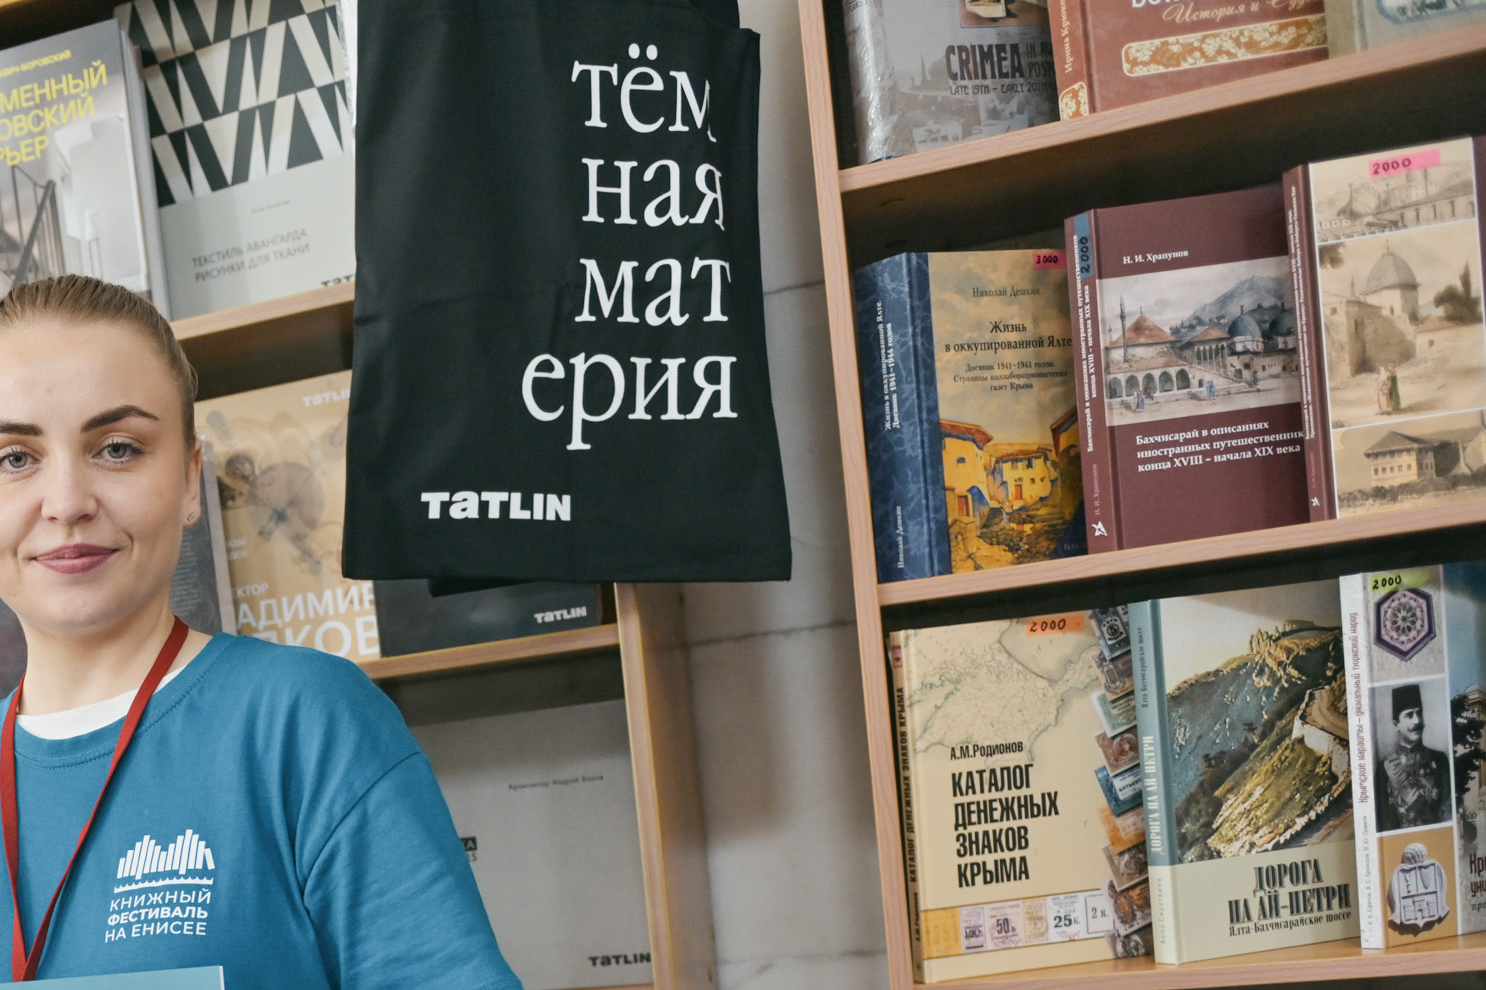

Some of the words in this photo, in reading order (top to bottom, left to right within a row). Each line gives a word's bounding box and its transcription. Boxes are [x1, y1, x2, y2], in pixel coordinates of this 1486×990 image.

[1162, 2, 1245, 25] История
[944, 42, 1026, 81] CRIMEA
[1372, 157, 1412, 175] 2000
[581, 157, 725, 231] ная
[192, 247, 244, 269] ТЕКСТИЛЬ
[246, 228, 308, 254] АВАНГАРДА
[195, 260, 246, 283] РИСУНКИ
[247, 254, 270, 271] ДЛЯ
[274, 243, 311, 262] ТКАНИ
[1034, 254, 1059, 265] 3000
[1079, 236, 1091, 274] 2000
[1122, 255, 1133, 265] Н.
[1135, 254, 1145, 263] И.
[1146, 250, 1189, 263] Храпунов
[574, 256, 731, 326] мат
[972, 286, 1008, 299] Николай
[1009, 286, 1041, 298] Дешкин
[989, 320, 1027, 335] Жизнь
[1077, 307, 1087, 359] иностранных
[877, 323, 890, 394] оккупированной
[945, 344, 951, 353] в
[953, 336, 1045, 356] оккупированной
[1046, 334, 1072, 349] Ялте
[953, 373, 988, 384] Страницы
[965, 362, 995, 373] Дневник
[1080, 360, 1090, 401] описаниях
[521, 352, 738, 451] ерия
[989, 383, 1008, 392] газет
[1009, 382, 1034, 392] Крыма
[884, 401, 892, 430] Жизнь
[891, 393, 901, 429] Дневник
[1084, 408, 1094, 452] Бахчисарай
[1135, 427, 1199, 447] Бахчисарай
[1201, 429, 1208, 437] в
[1210, 421, 1269, 438] описаниях
[1136, 440, 1211, 460] иностранных
[1137, 460, 1172, 473] конца
[1173, 454, 1203, 467] XVIII
[1213, 449, 1252, 464] начала
[1254, 446, 1274, 458] XIX
[1276, 443, 1301, 455] века
[896, 536, 906, 568] Николай
[1372, 574, 1402, 591] 2000
[1029, 619, 1066, 632] 2000
[1347, 612, 1359, 634] народ
[1350, 636, 1362, 671] тюркский
[895, 686, 906, 727] КРЫМА
[1351, 673, 1364, 717] уникальный
[898, 730, 909, 772] ЗНАКОВ
[949, 741, 1024, 760] А.М.Родионов
[1142, 735, 1158, 793] АЙ-ПЕТРИ
[951, 763, 1034, 797] КАТАЛОГ
[1356, 763, 1369, 803] Крымские
[903, 774, 915, 833] ДЕНЕЖНЫХ
[953, 791, 1060, 831] ДЕНЕЖНЫХ
[1148, 795, 1160, 810] НА
[956, 825, 1030, 858] ЗНАКОВ
[1150, 812, 1164, 855] ДОРОГА
[906, 835, 918, 883] КАТАЛОГ
[957, 855, 1030, 888] КРЫМА
[1252, 857, 1323, 896] ДОРОГА
[107, 906, 208, 926] ФЕСТИВАЛЬ
[109, 887, 212, 912] КНИЖНЫЙ
[1228, 898, 1254, 924] НА
[1257, 882, 1352, 920] АЙ-ПЕТРИ
[104, 926, 127, 944] НА
[131, 920, 208, 938] ЕНИСЕЕ
[996, 917, 1010, 935] 50
[1053, 914, 1073, 928] 25
[1325, 910, 1352, 923] шоссе
